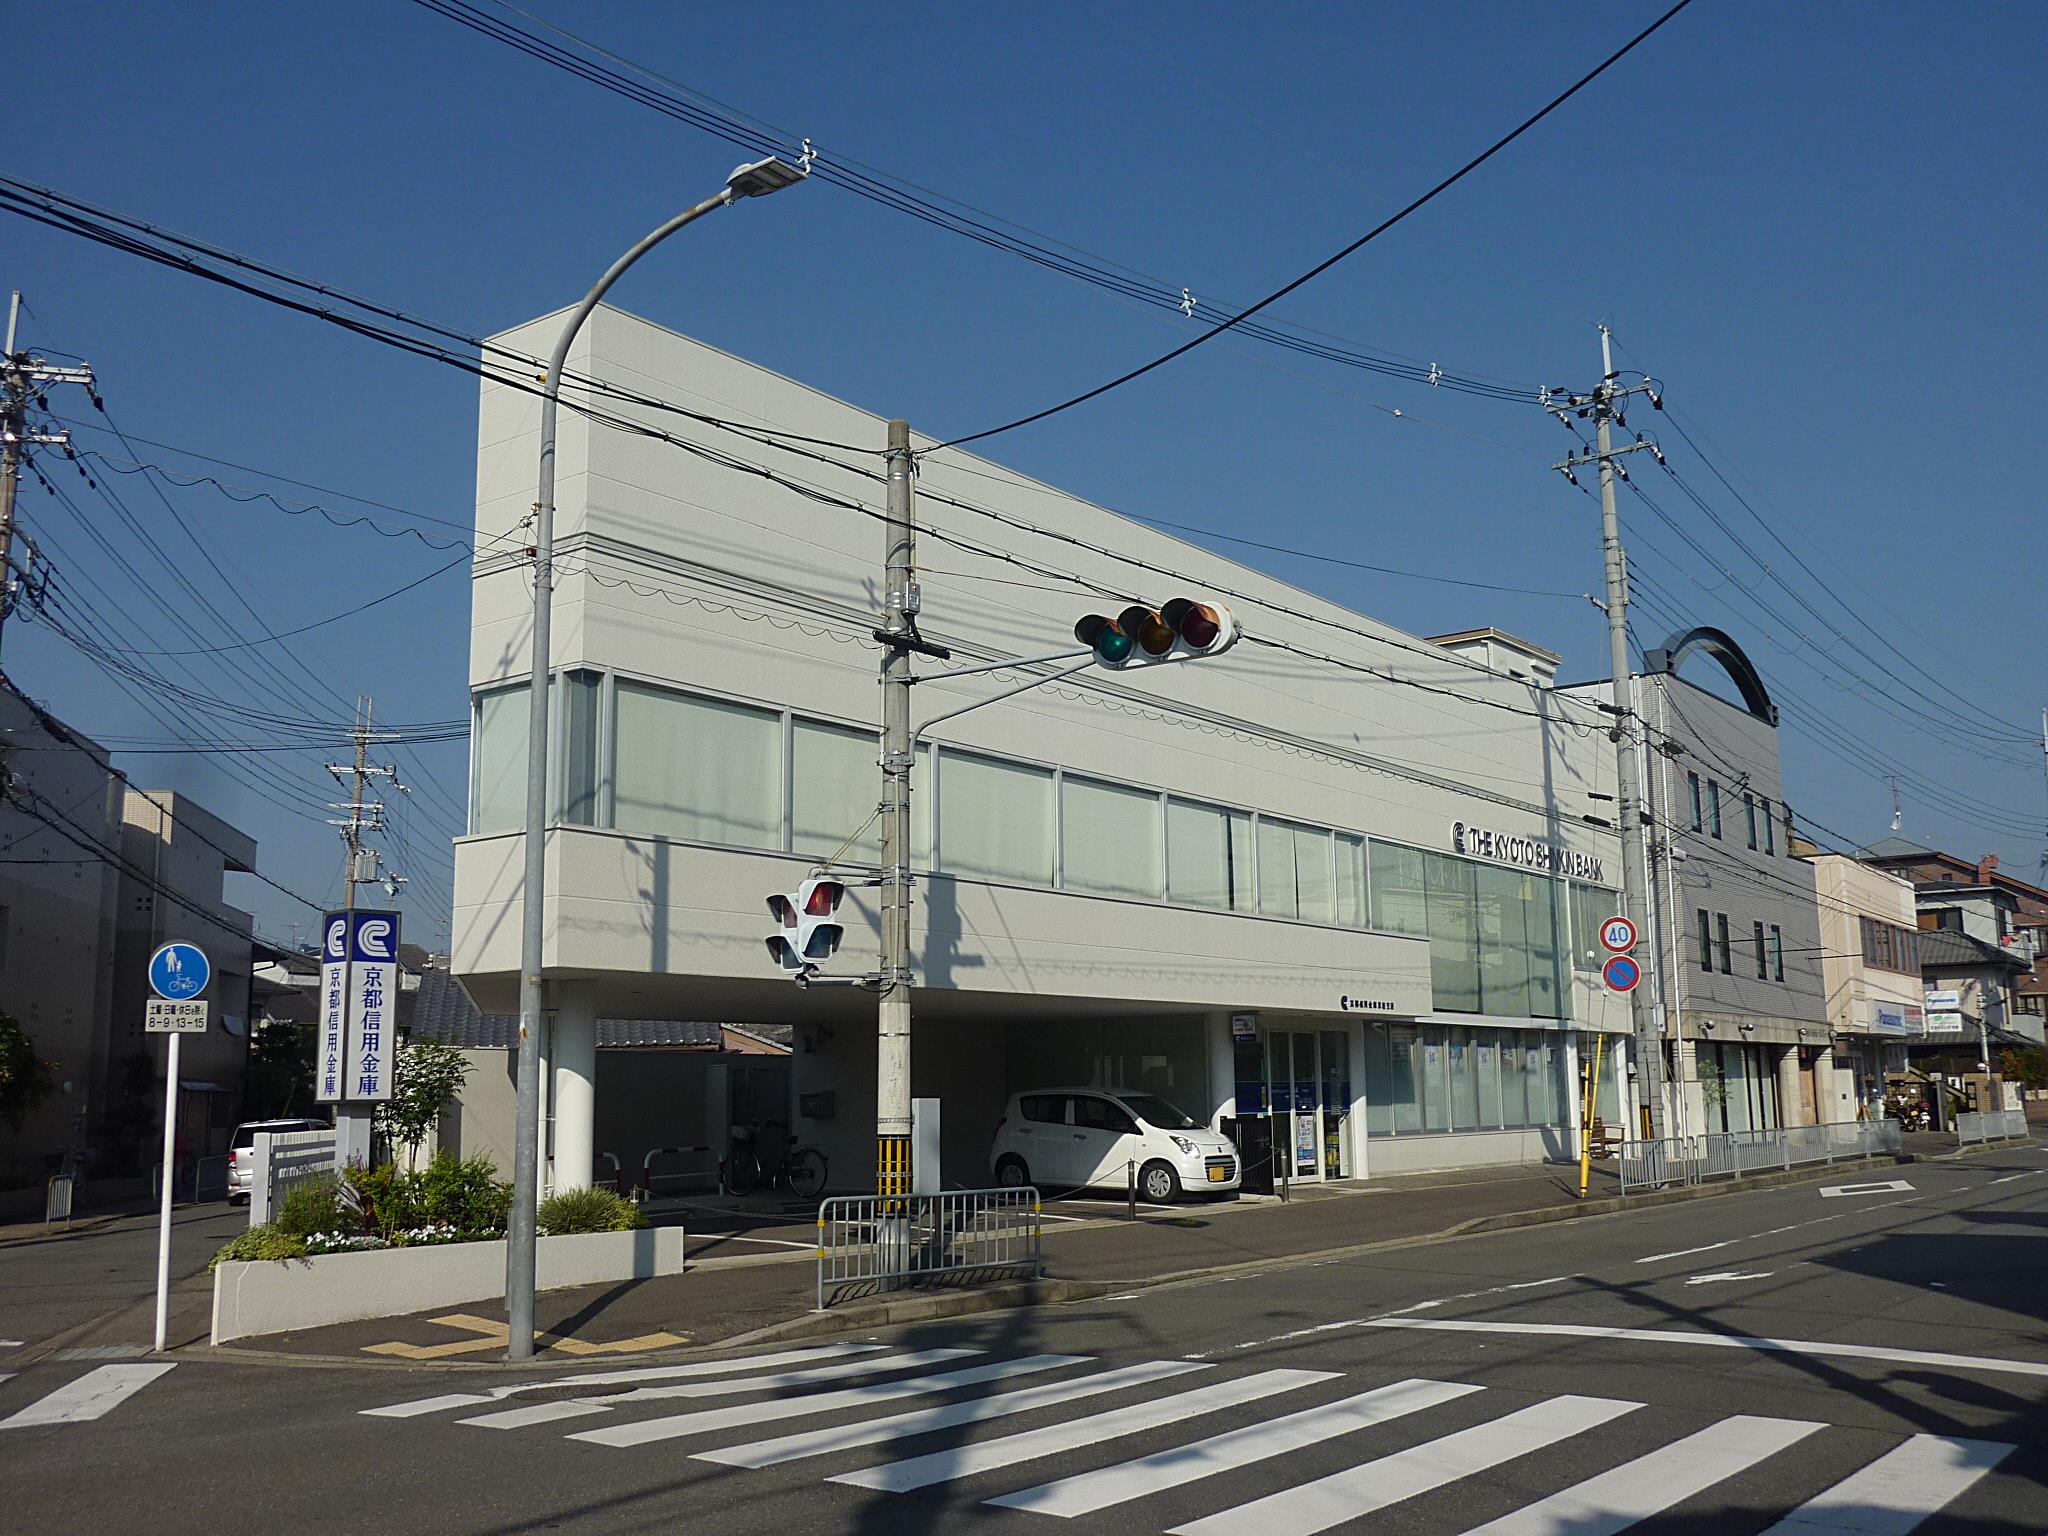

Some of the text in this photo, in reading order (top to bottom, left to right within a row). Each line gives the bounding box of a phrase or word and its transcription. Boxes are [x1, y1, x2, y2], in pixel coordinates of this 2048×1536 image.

[1468, 828, 1604, 882] THE KYOTO SHINKIN BANK
[1608, 927, 1629, 943] 40
[324, 967, 341, 1096] 京都信用金庫
[358, 967, 383, 1096] 京都信用金庫
